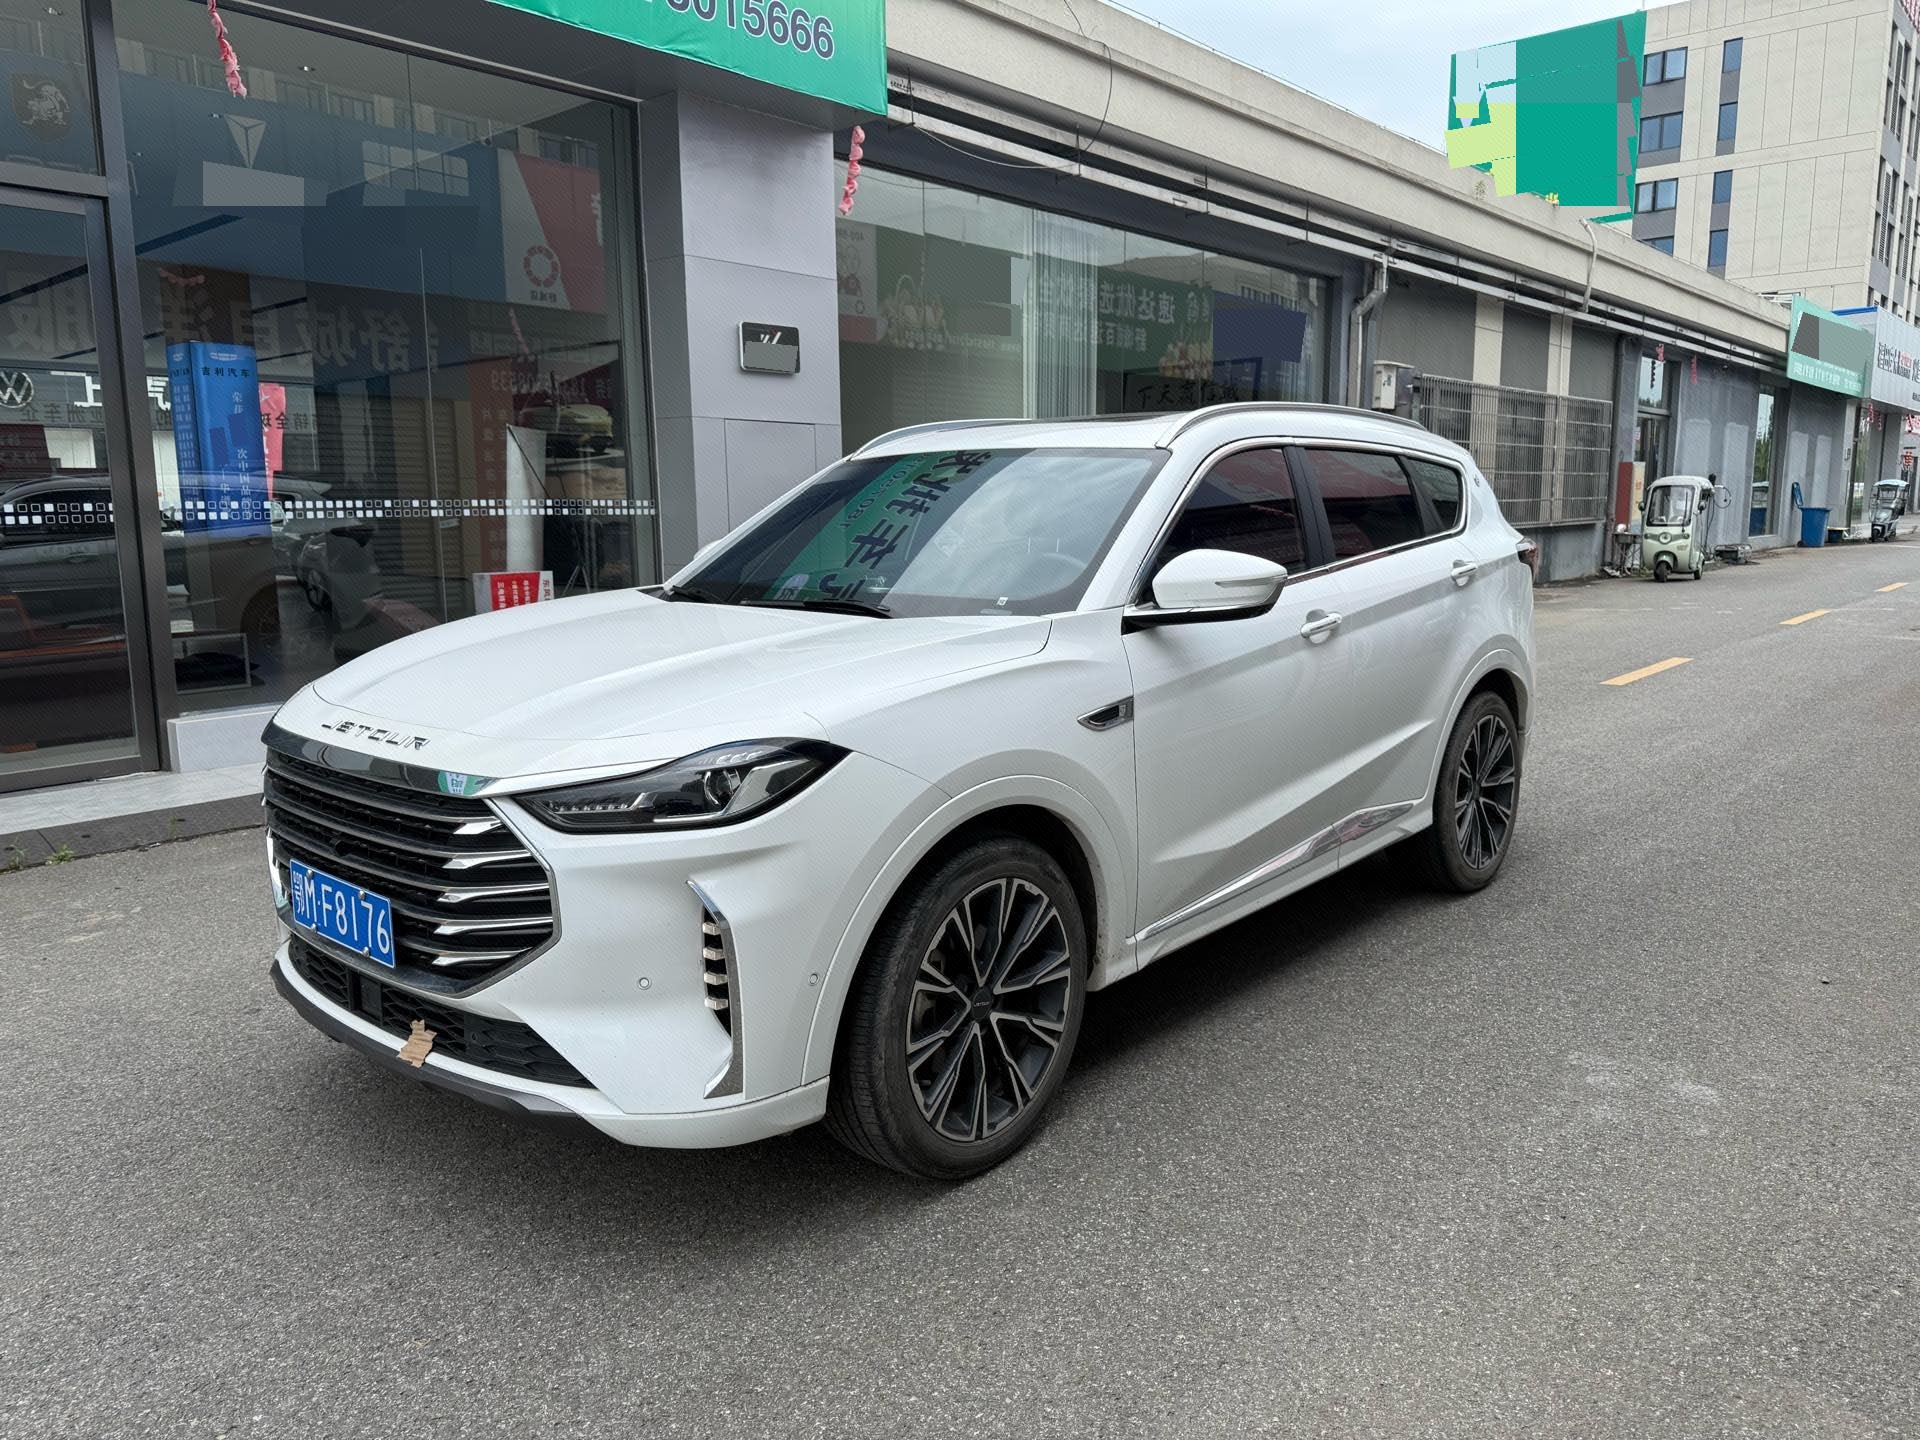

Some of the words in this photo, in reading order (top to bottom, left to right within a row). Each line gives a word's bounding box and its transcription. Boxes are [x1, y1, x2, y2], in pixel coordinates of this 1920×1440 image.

[665, 0, 835, 60] 015666
[201, 366, 250, 378] 吉利汽车
[321, 718, 431, 751] JETOUR
